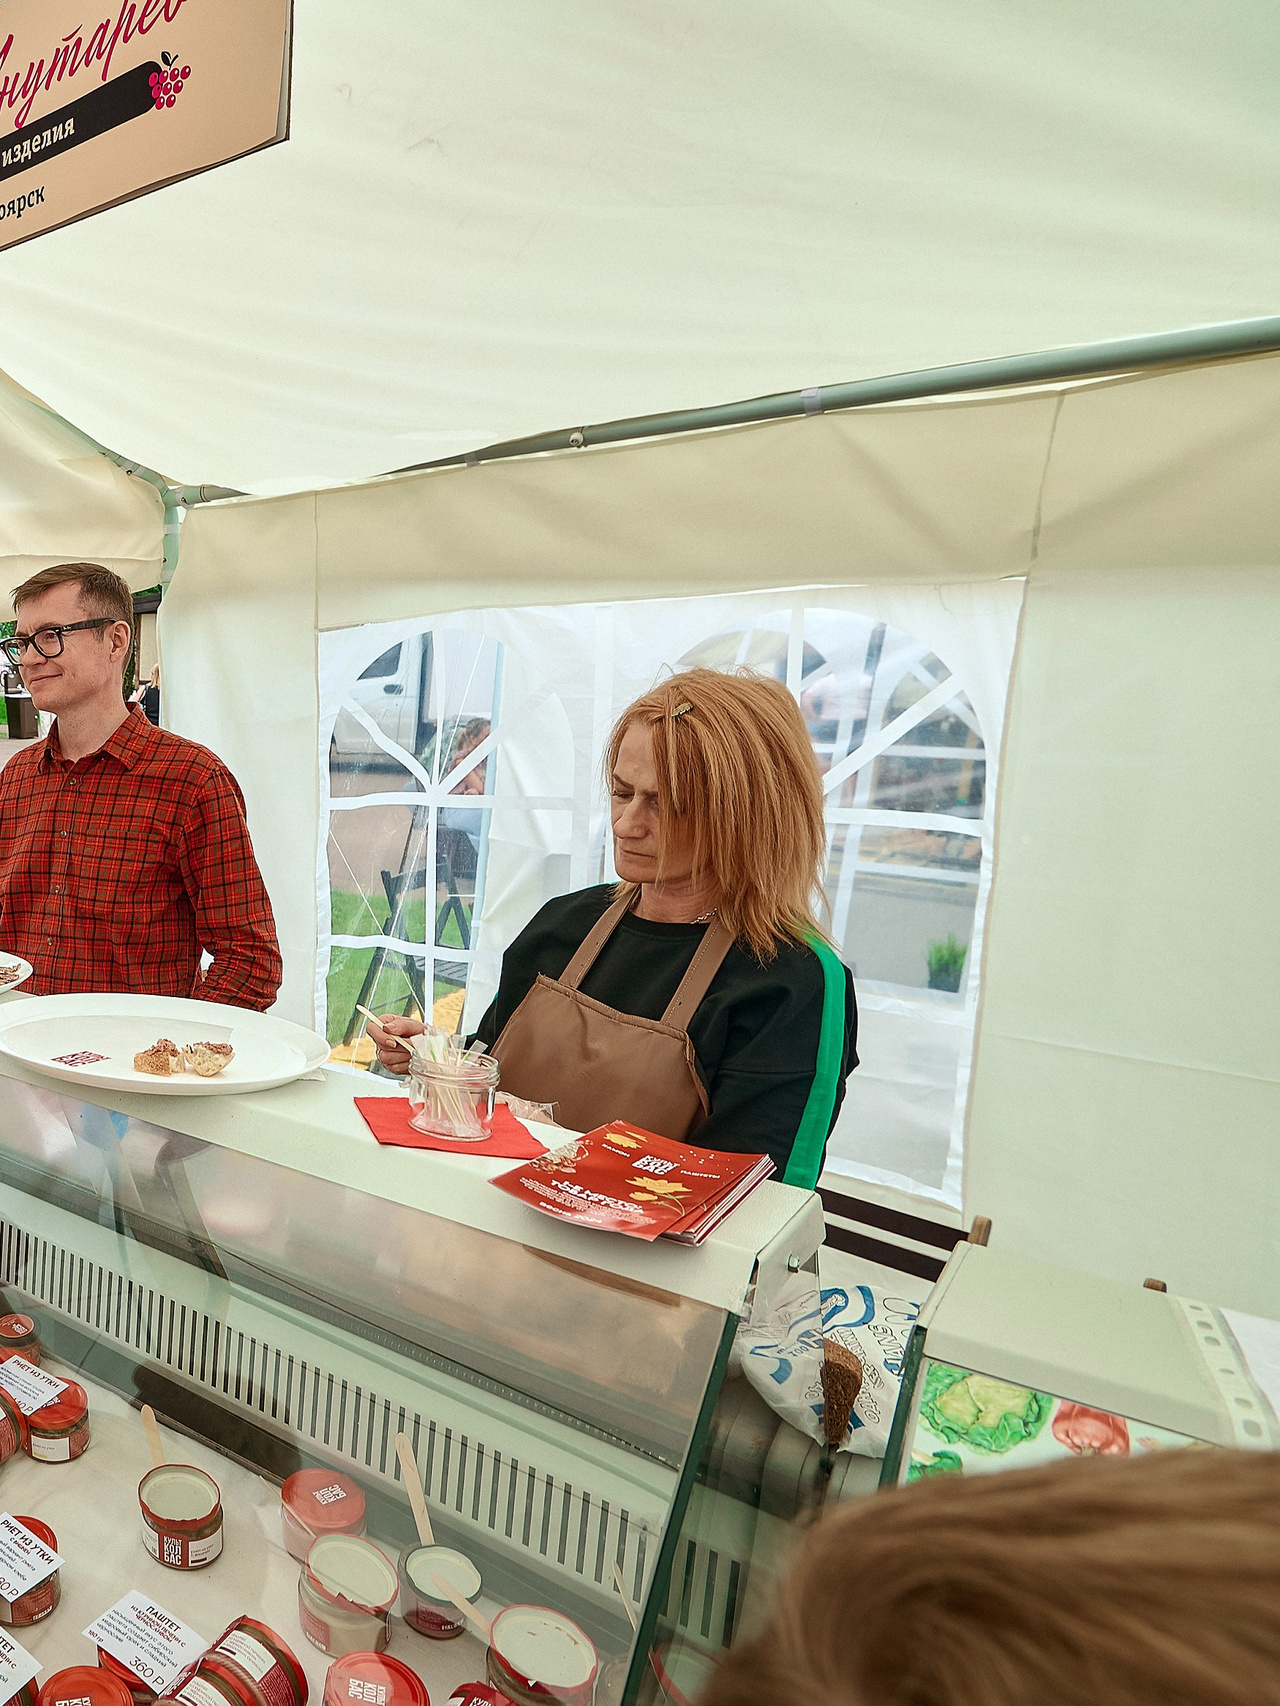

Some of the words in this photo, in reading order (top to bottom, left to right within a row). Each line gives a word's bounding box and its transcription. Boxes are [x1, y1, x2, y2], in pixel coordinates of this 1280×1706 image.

[2, 118, 75, 168] изделия
[601, 1143, 631, 1157] ХАМОН
[550, 1179, 600, 1202] ТОВАР
[12, 1359, 31, 1371] РИЕТ
[29, 1369, 40, 1377] ИЗ
[39, 1375, 59, 1388] УТКИ
[319, 1488, 337, 1503] КОЛ
[328, 1484, 347, 1499] БАС
[0, 1519, 22, 1536] РИЕТ
[19, 1534, 32, 1546] ИЗ
[30, 1543, 54, 1564] УТКИ
[163, 1536, 183, 1546] КУЛЬТ
[164, 1543, 182, 1555] КОЛ
[164, 1551, 182, 1566] БАС
[146, 1605, 181, 1631] ПАШТЕТ
[129, 1655, 154, 1677] 360
[348, 1678, 364, 1700] БАС
[362, 1681, 377, 1704] КОЛ
